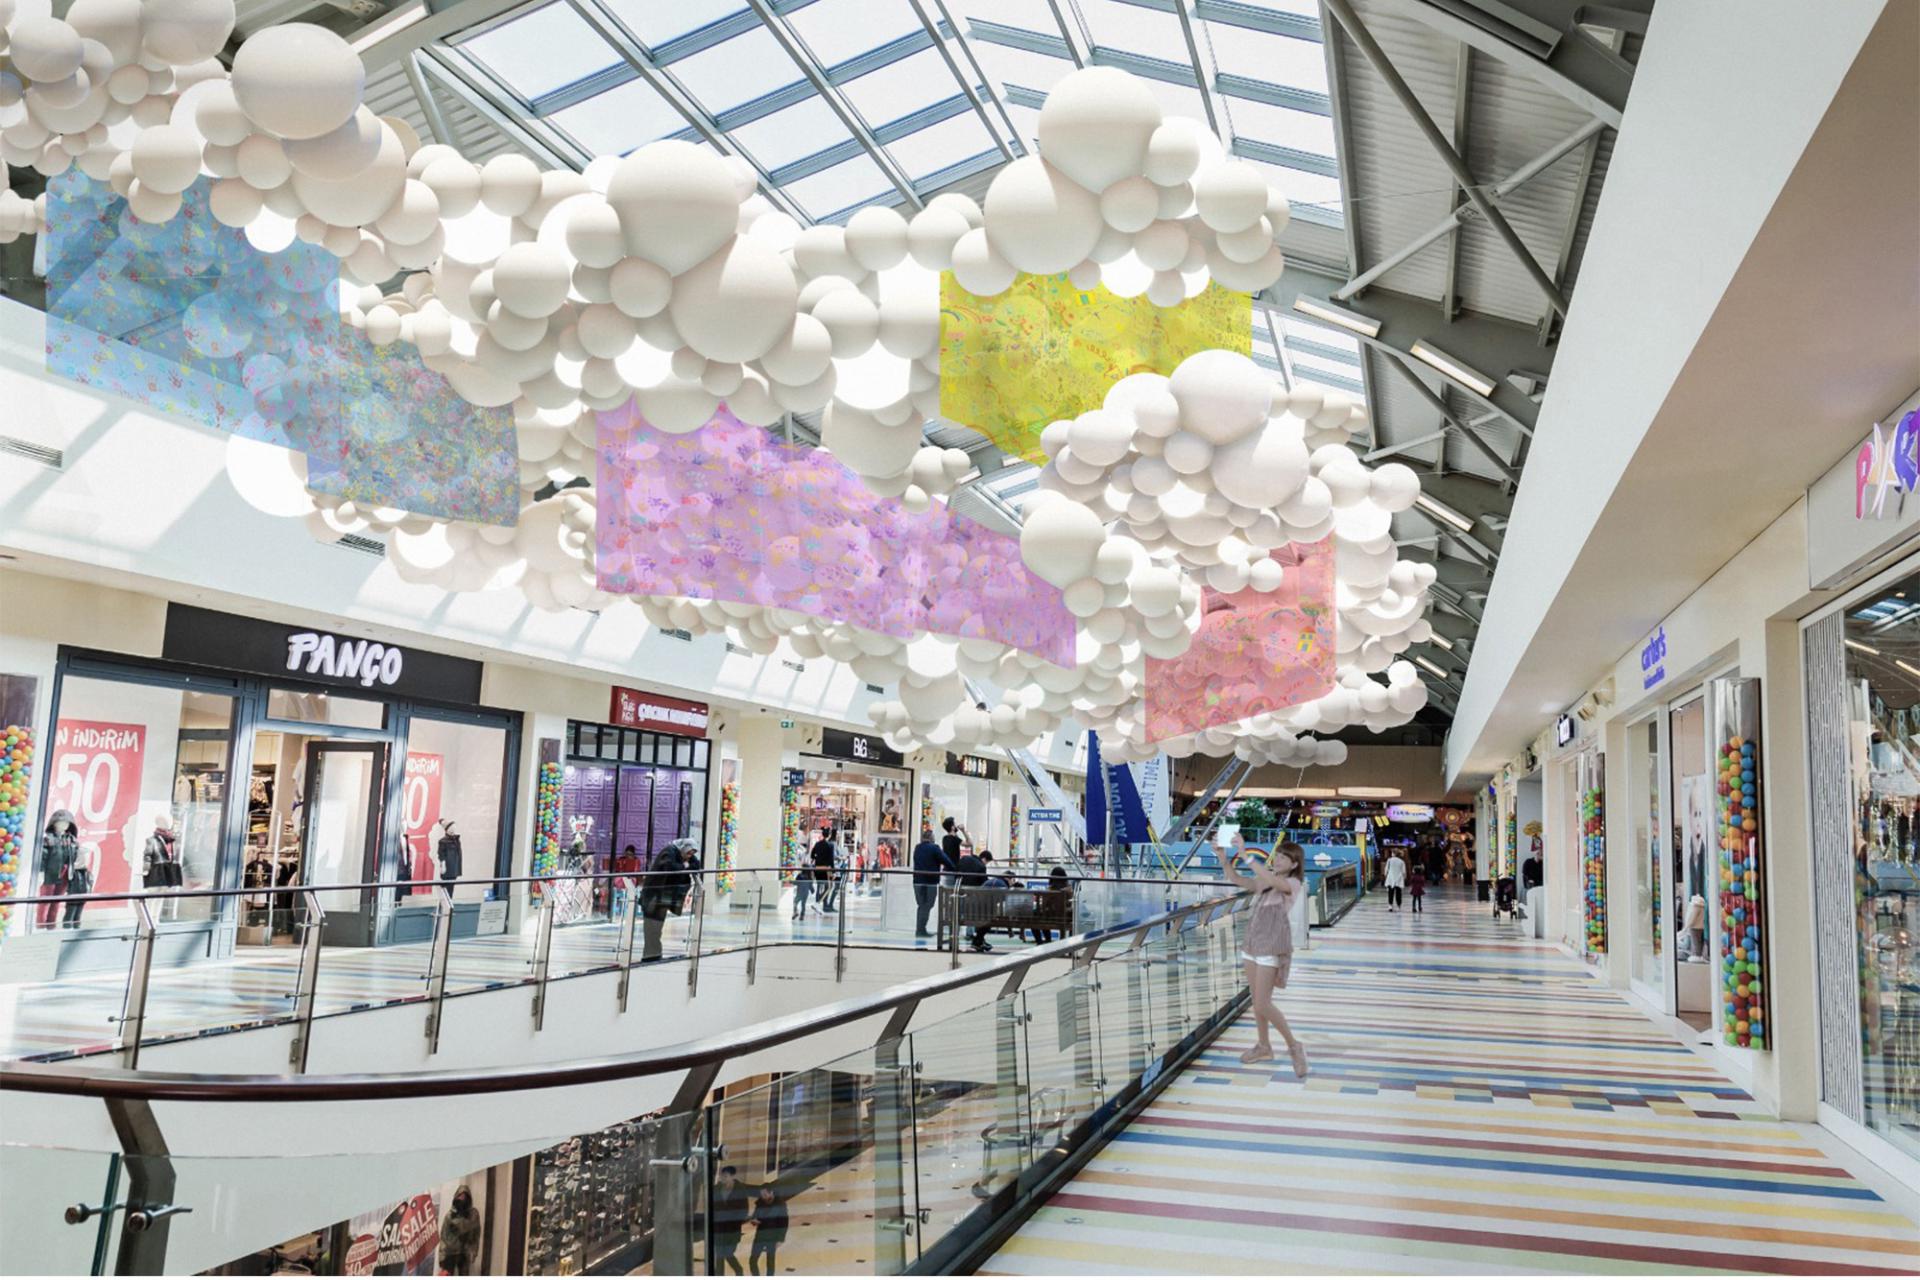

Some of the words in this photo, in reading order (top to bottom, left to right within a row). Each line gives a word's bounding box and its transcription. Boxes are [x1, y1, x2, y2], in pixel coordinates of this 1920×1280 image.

[287, 632, 402, 687] PANÇO
[54, 752, 120, 823] 50
[381, 1223, 402, 1248] SAL
[402, 1200, 435, 1245] SALE
